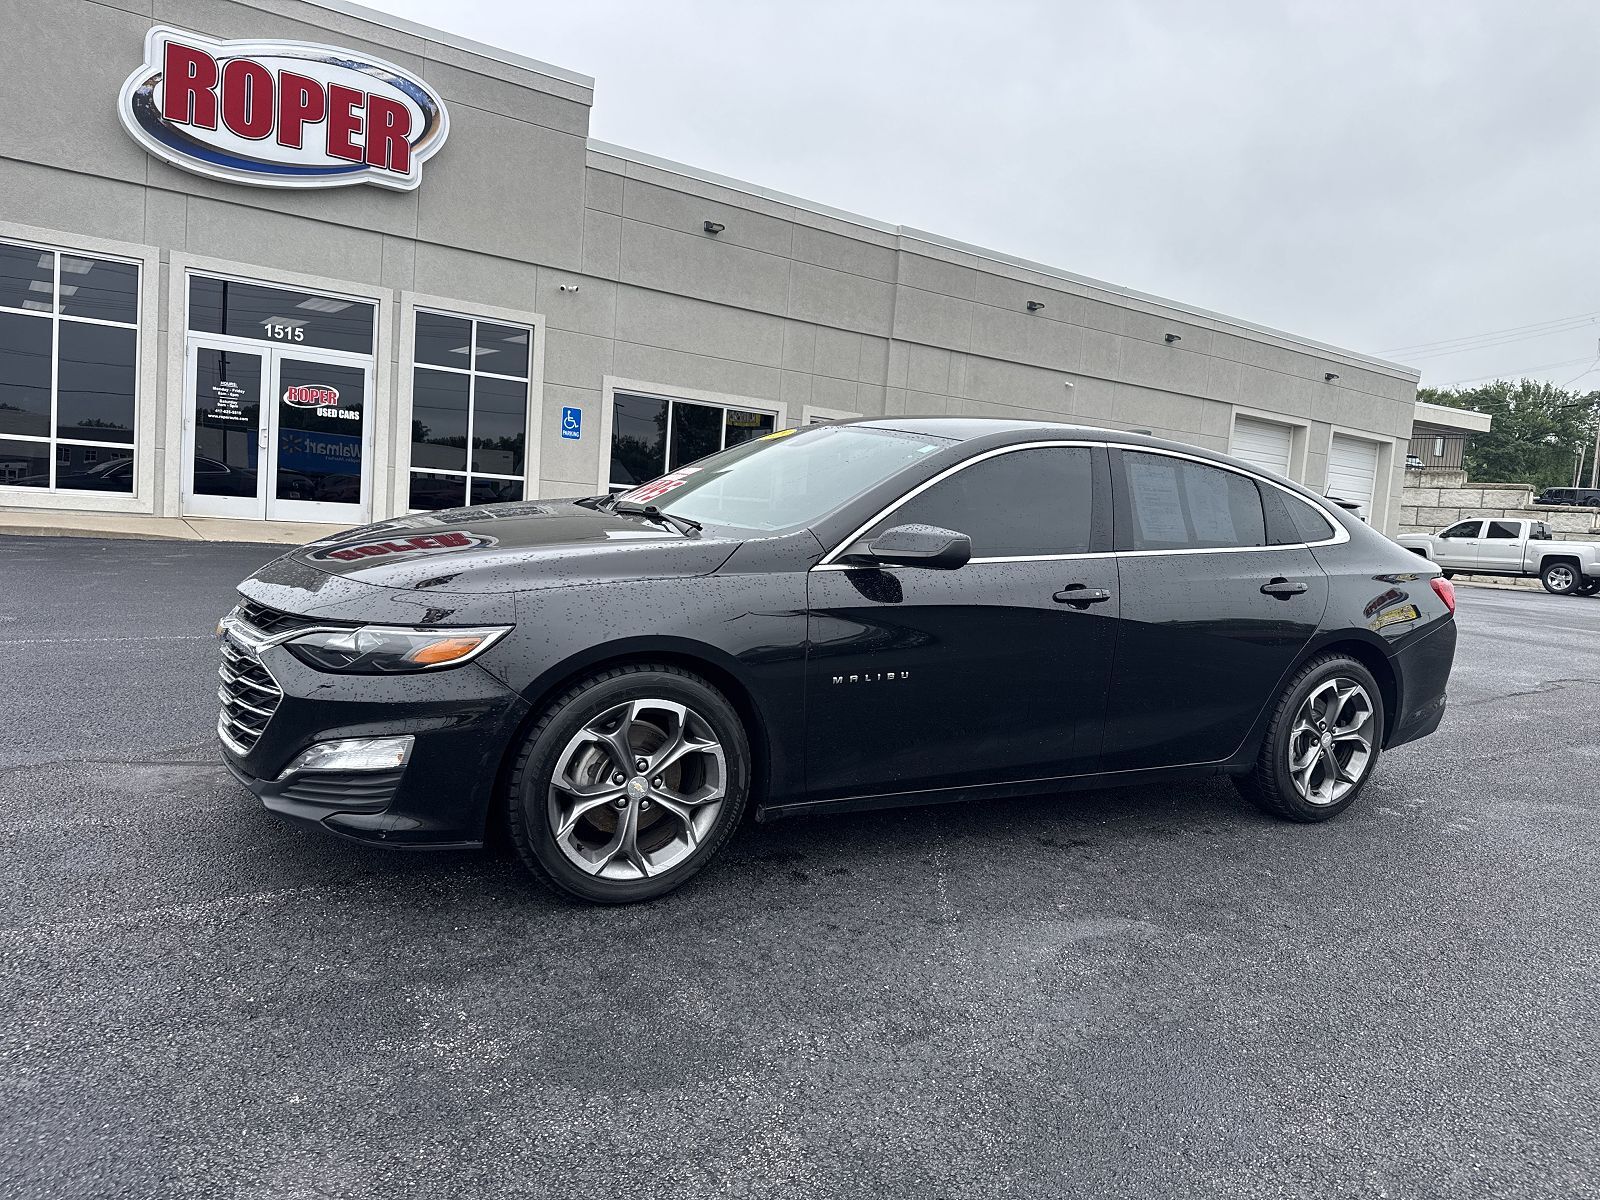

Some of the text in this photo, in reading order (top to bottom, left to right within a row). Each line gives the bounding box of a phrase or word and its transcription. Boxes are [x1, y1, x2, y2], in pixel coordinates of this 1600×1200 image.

[162, 40, 412, 174] ROPER
[264, 323, 304, 341] 1515
[287, 386, 338, 405] ROPER
[316, 408, 360, 421] USED CARS
[832, 671, 909, 685] MALIBU
